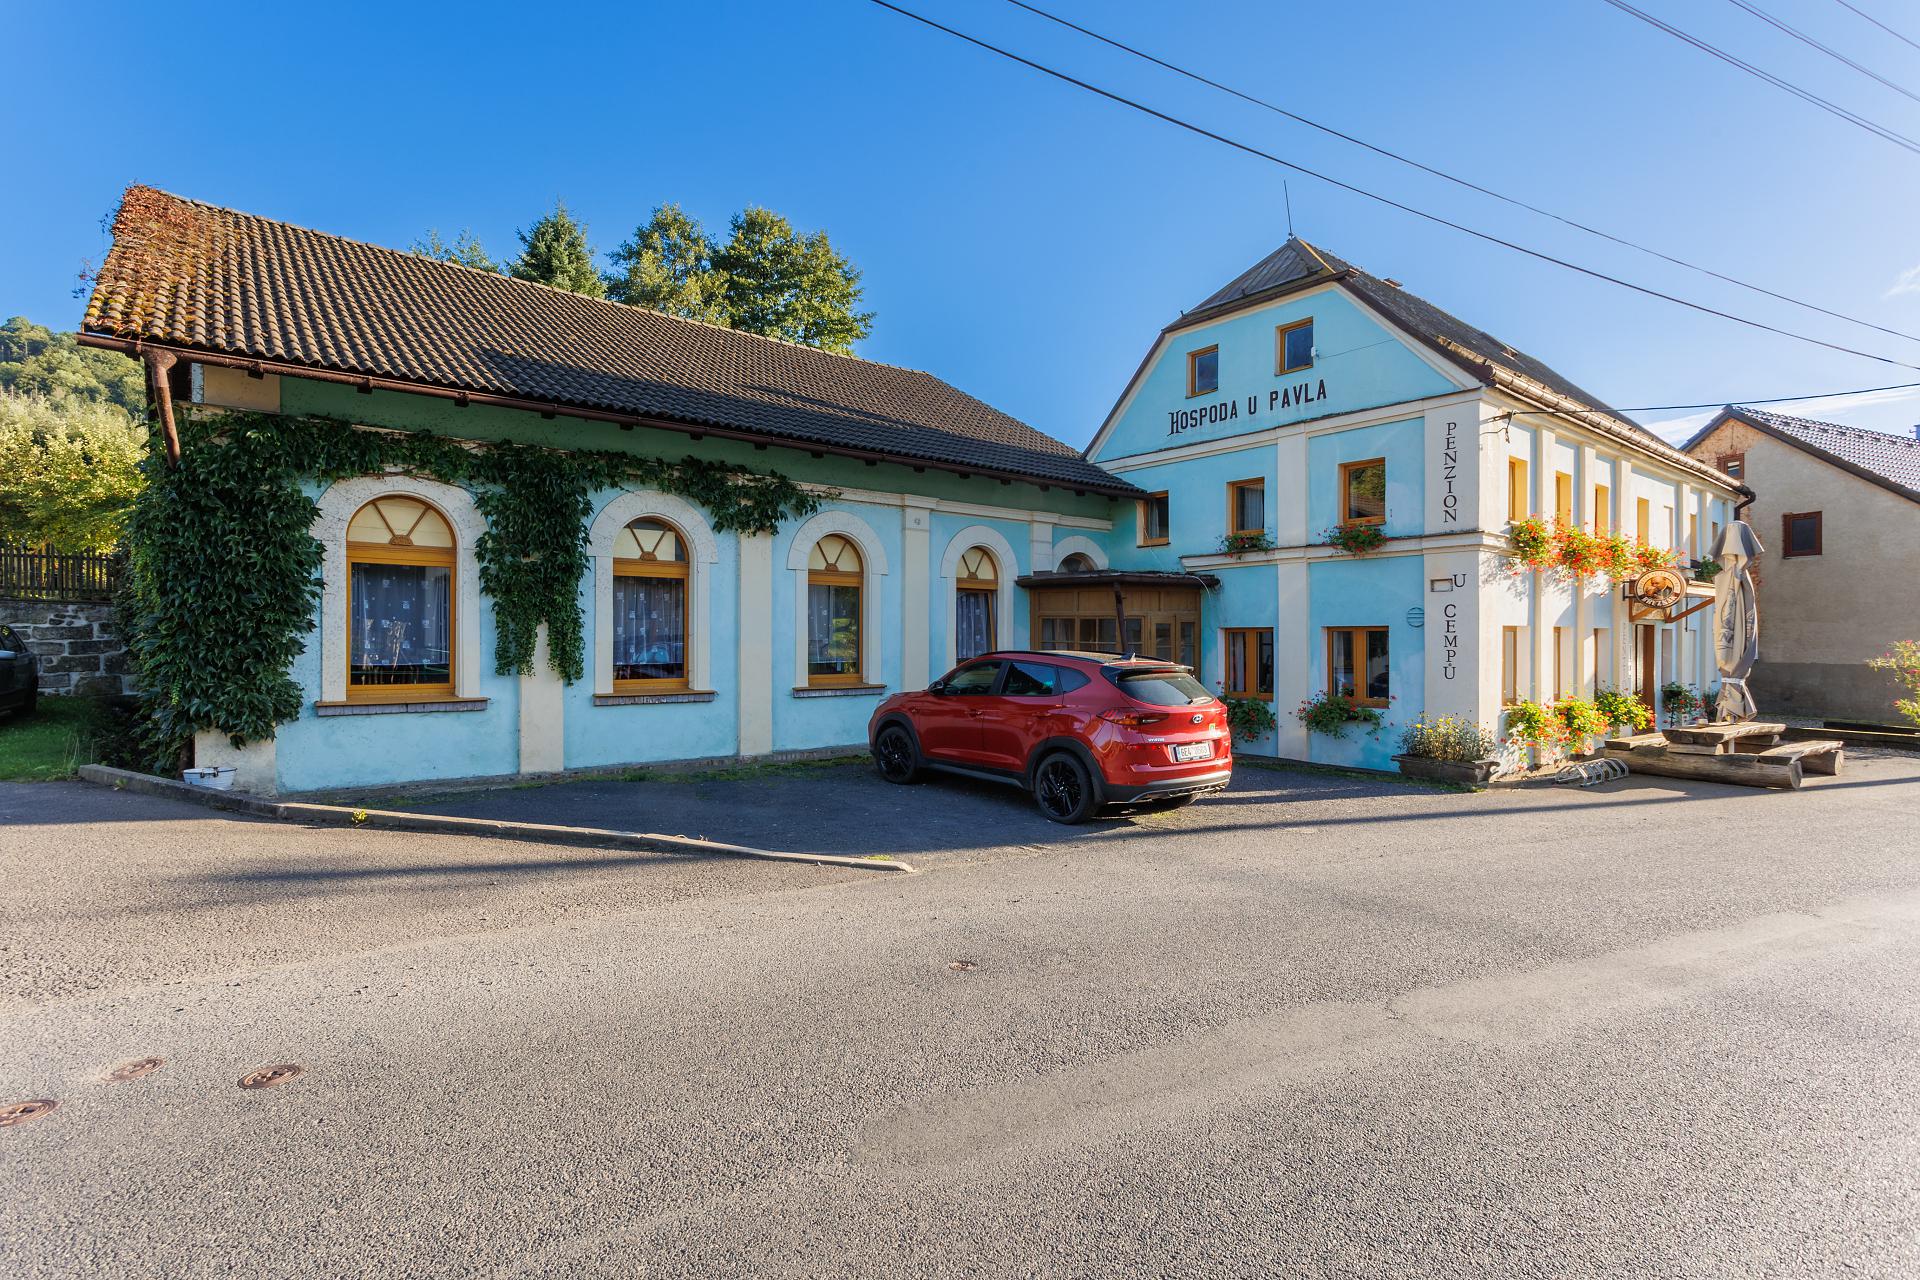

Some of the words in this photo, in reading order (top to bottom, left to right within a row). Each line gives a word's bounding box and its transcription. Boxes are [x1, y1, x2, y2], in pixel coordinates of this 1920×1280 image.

[1167, 400, 1238, 437] HOSPODA
[1248, 395, 1257, 415] U
[1269, 379, 1327, 411] PAVLA
[1443, 422, 1457, 523] PENZION
[1452, 573, 1467, 588] U
